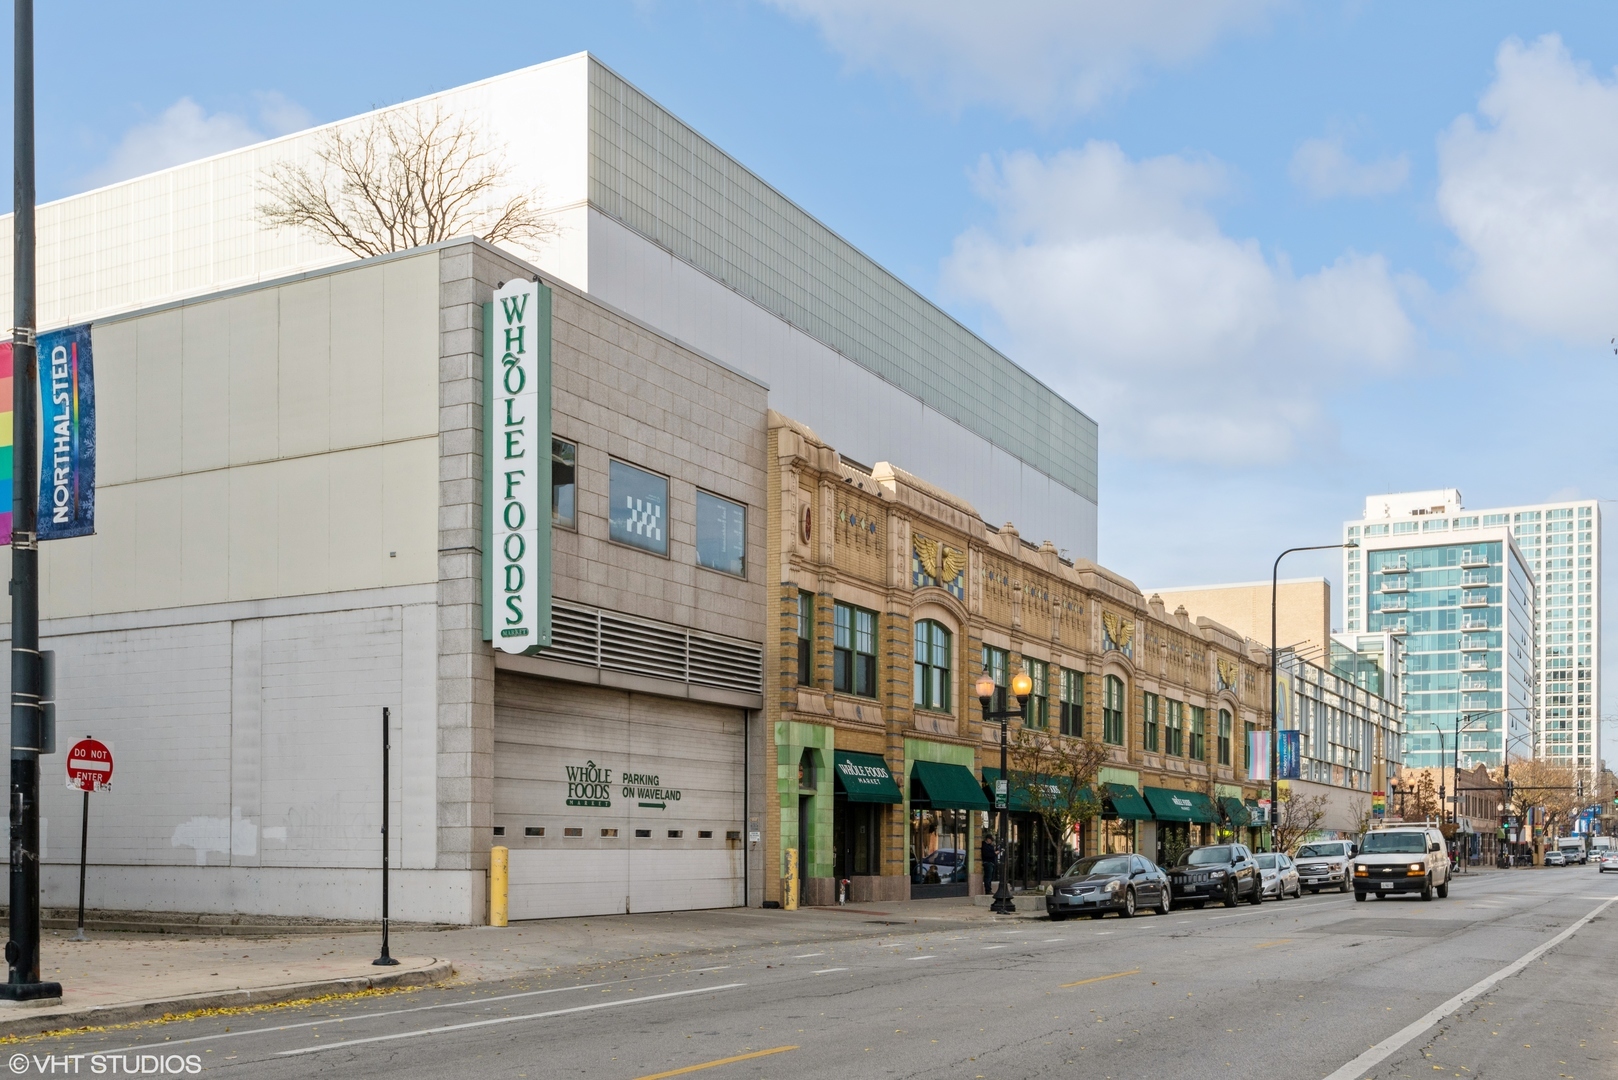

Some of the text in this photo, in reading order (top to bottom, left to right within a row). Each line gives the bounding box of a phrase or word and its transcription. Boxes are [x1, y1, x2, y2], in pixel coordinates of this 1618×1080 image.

[51, 345, 70, 523] NORTHALSTED
[500, 293, 530, 626] WHOLE FOODS
[74, 749, 107, 760] DO NOT
[77, 771, 103, 782] ENTER
[565, 760, 612, 784] WHOLE
[838, 759, 889, 778] WHOLE FOODS
[622, 773, 660, 786] PARKING
[568, 782, 610, 800] FOODS
[622, 787, 681, 801] ON WAVELAND
